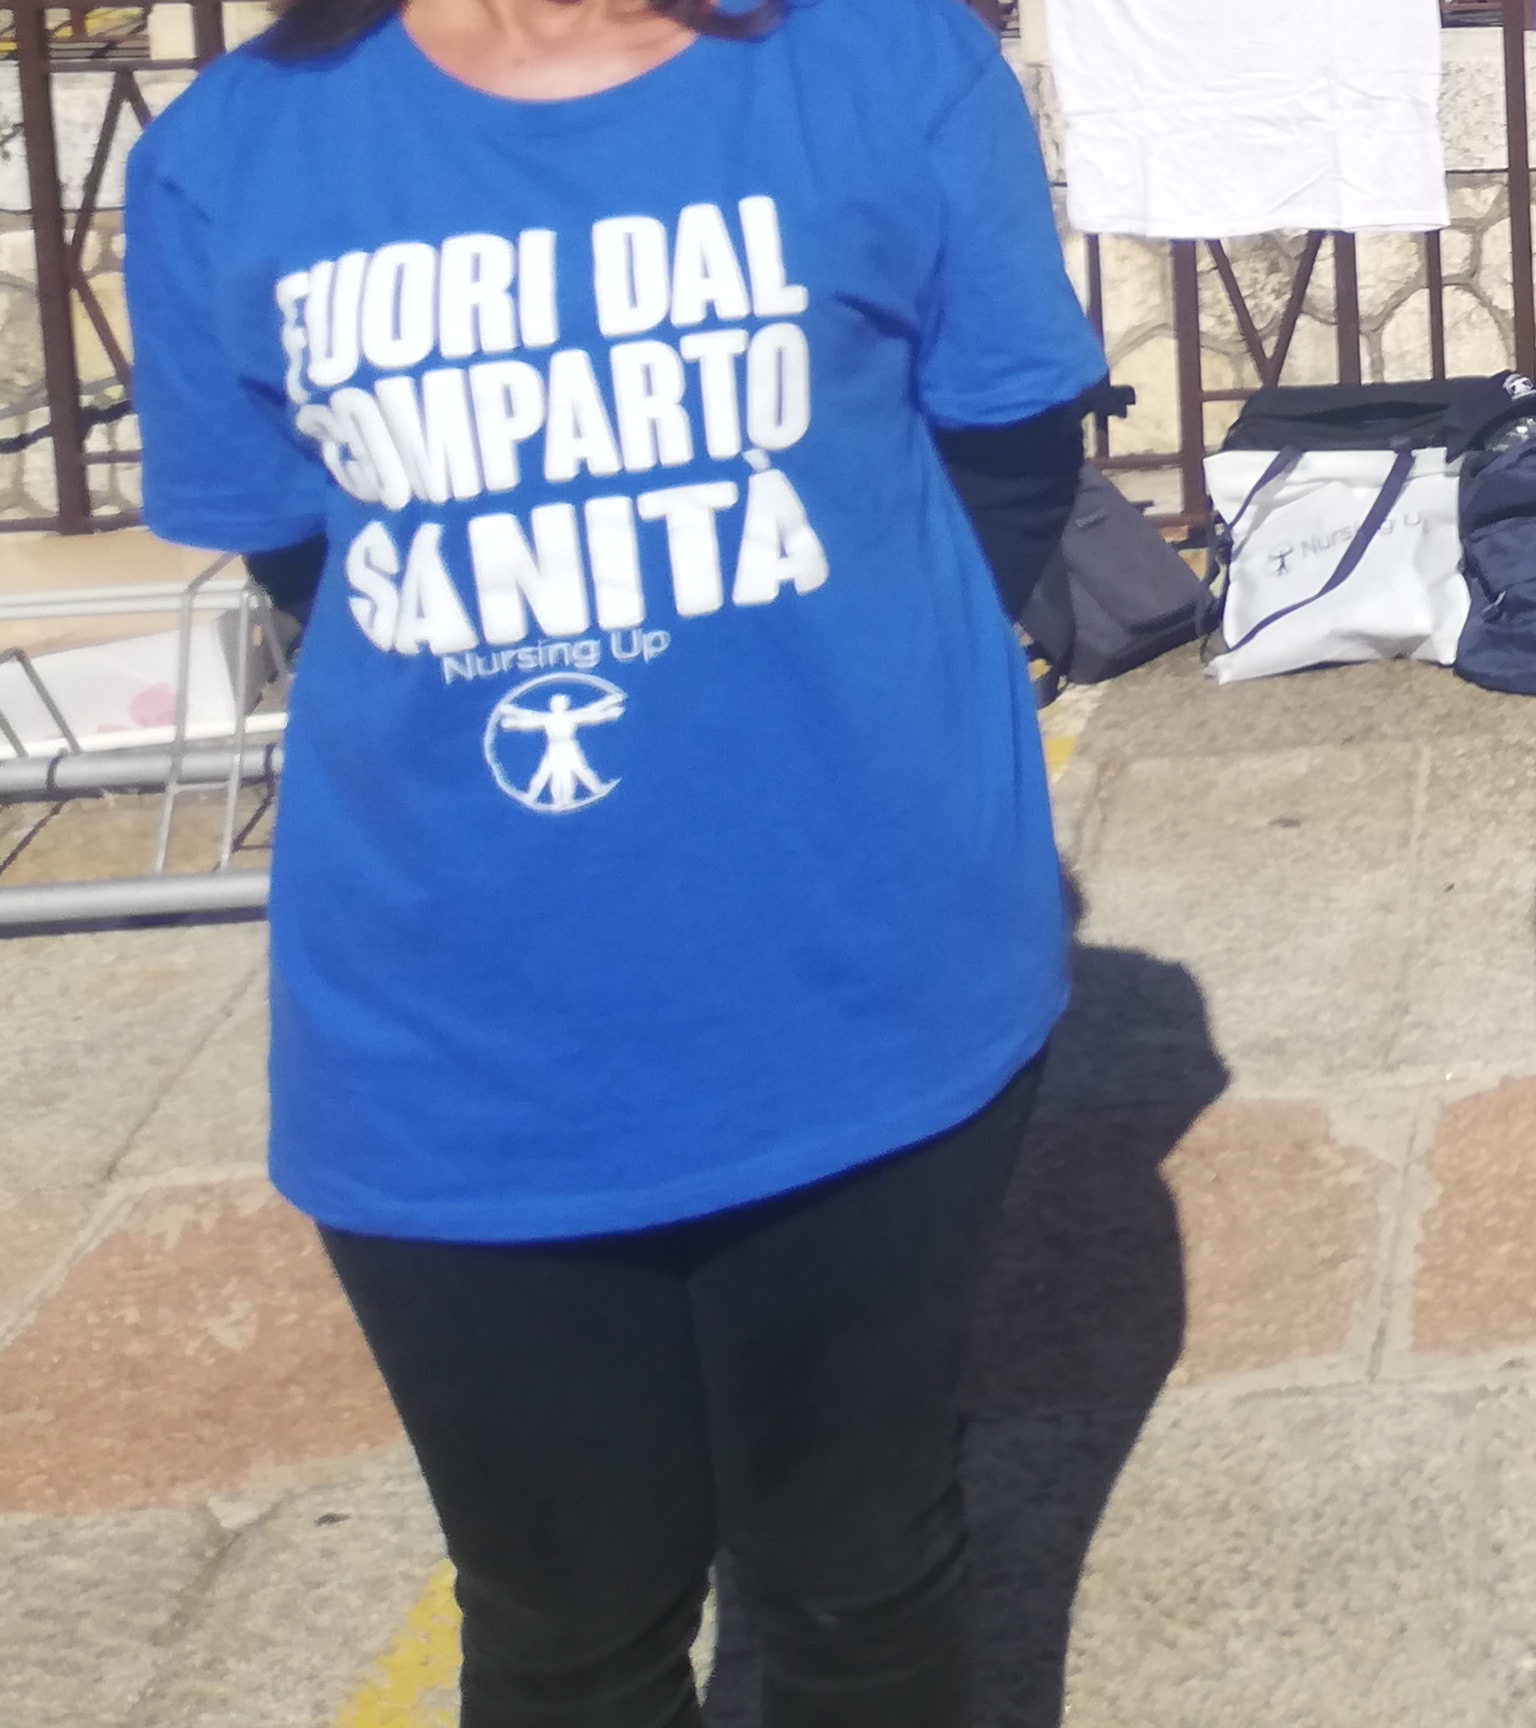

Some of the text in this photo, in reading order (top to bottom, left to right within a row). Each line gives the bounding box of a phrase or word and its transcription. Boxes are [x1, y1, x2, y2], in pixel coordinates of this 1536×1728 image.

[274, 195, 809, 405] FUORI DAL
[295, 322, 811, 511] COMPARTO
[345, 448, 829, 656] SANITÀ
[441, 627, 671, 685] Nursing Up
